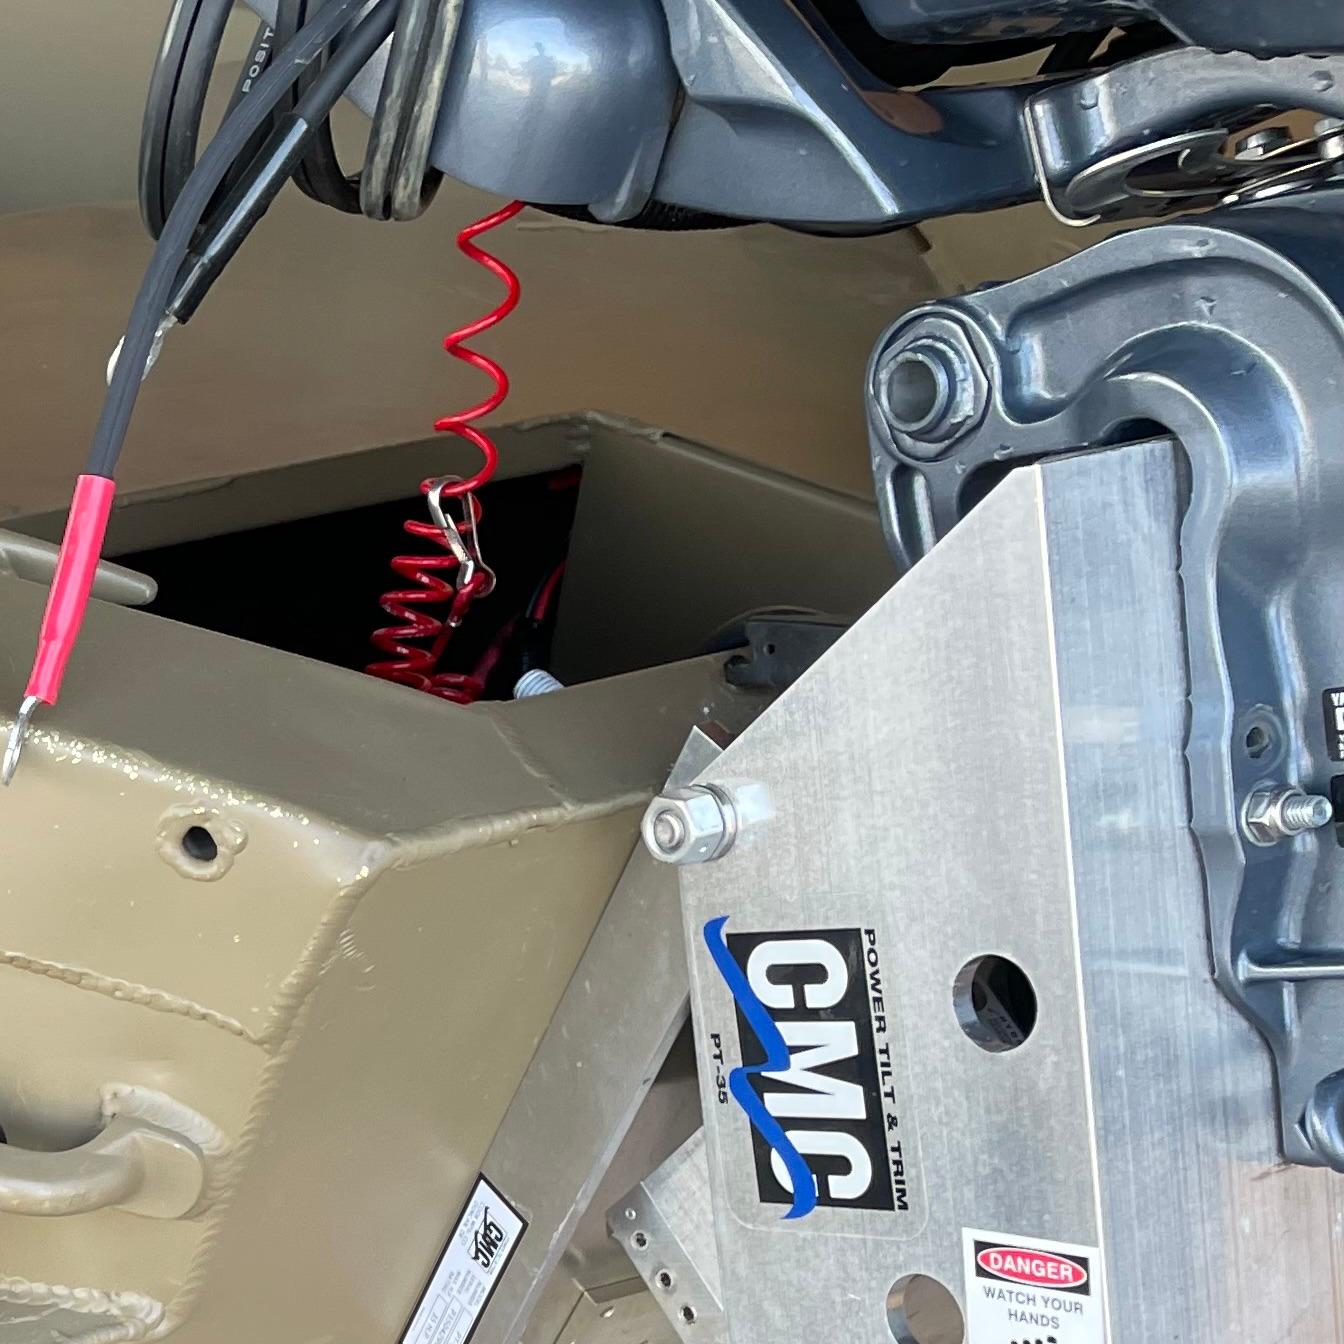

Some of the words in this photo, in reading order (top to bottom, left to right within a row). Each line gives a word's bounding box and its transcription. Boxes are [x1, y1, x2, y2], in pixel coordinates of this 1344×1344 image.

[864, 928, 888, 1034] POWER
[709, 1032, 729, 1105] PT-35
[746, 938, 872, 1201] CMC
[877, 1042, 897, 1104] TILT
[886, 1112, 900, 1132] &
[889, 1140, 909, 1212] TRIM
[480, 1218, 505, 1269] CMC
[988, 1252, 1075, 1284] DANGER
[982, 1285, 1037, 1307] WATCH
[1041, 1295, 1084, 1315] YOUR
[1007, 1307, 1060, 1330] HANDS
